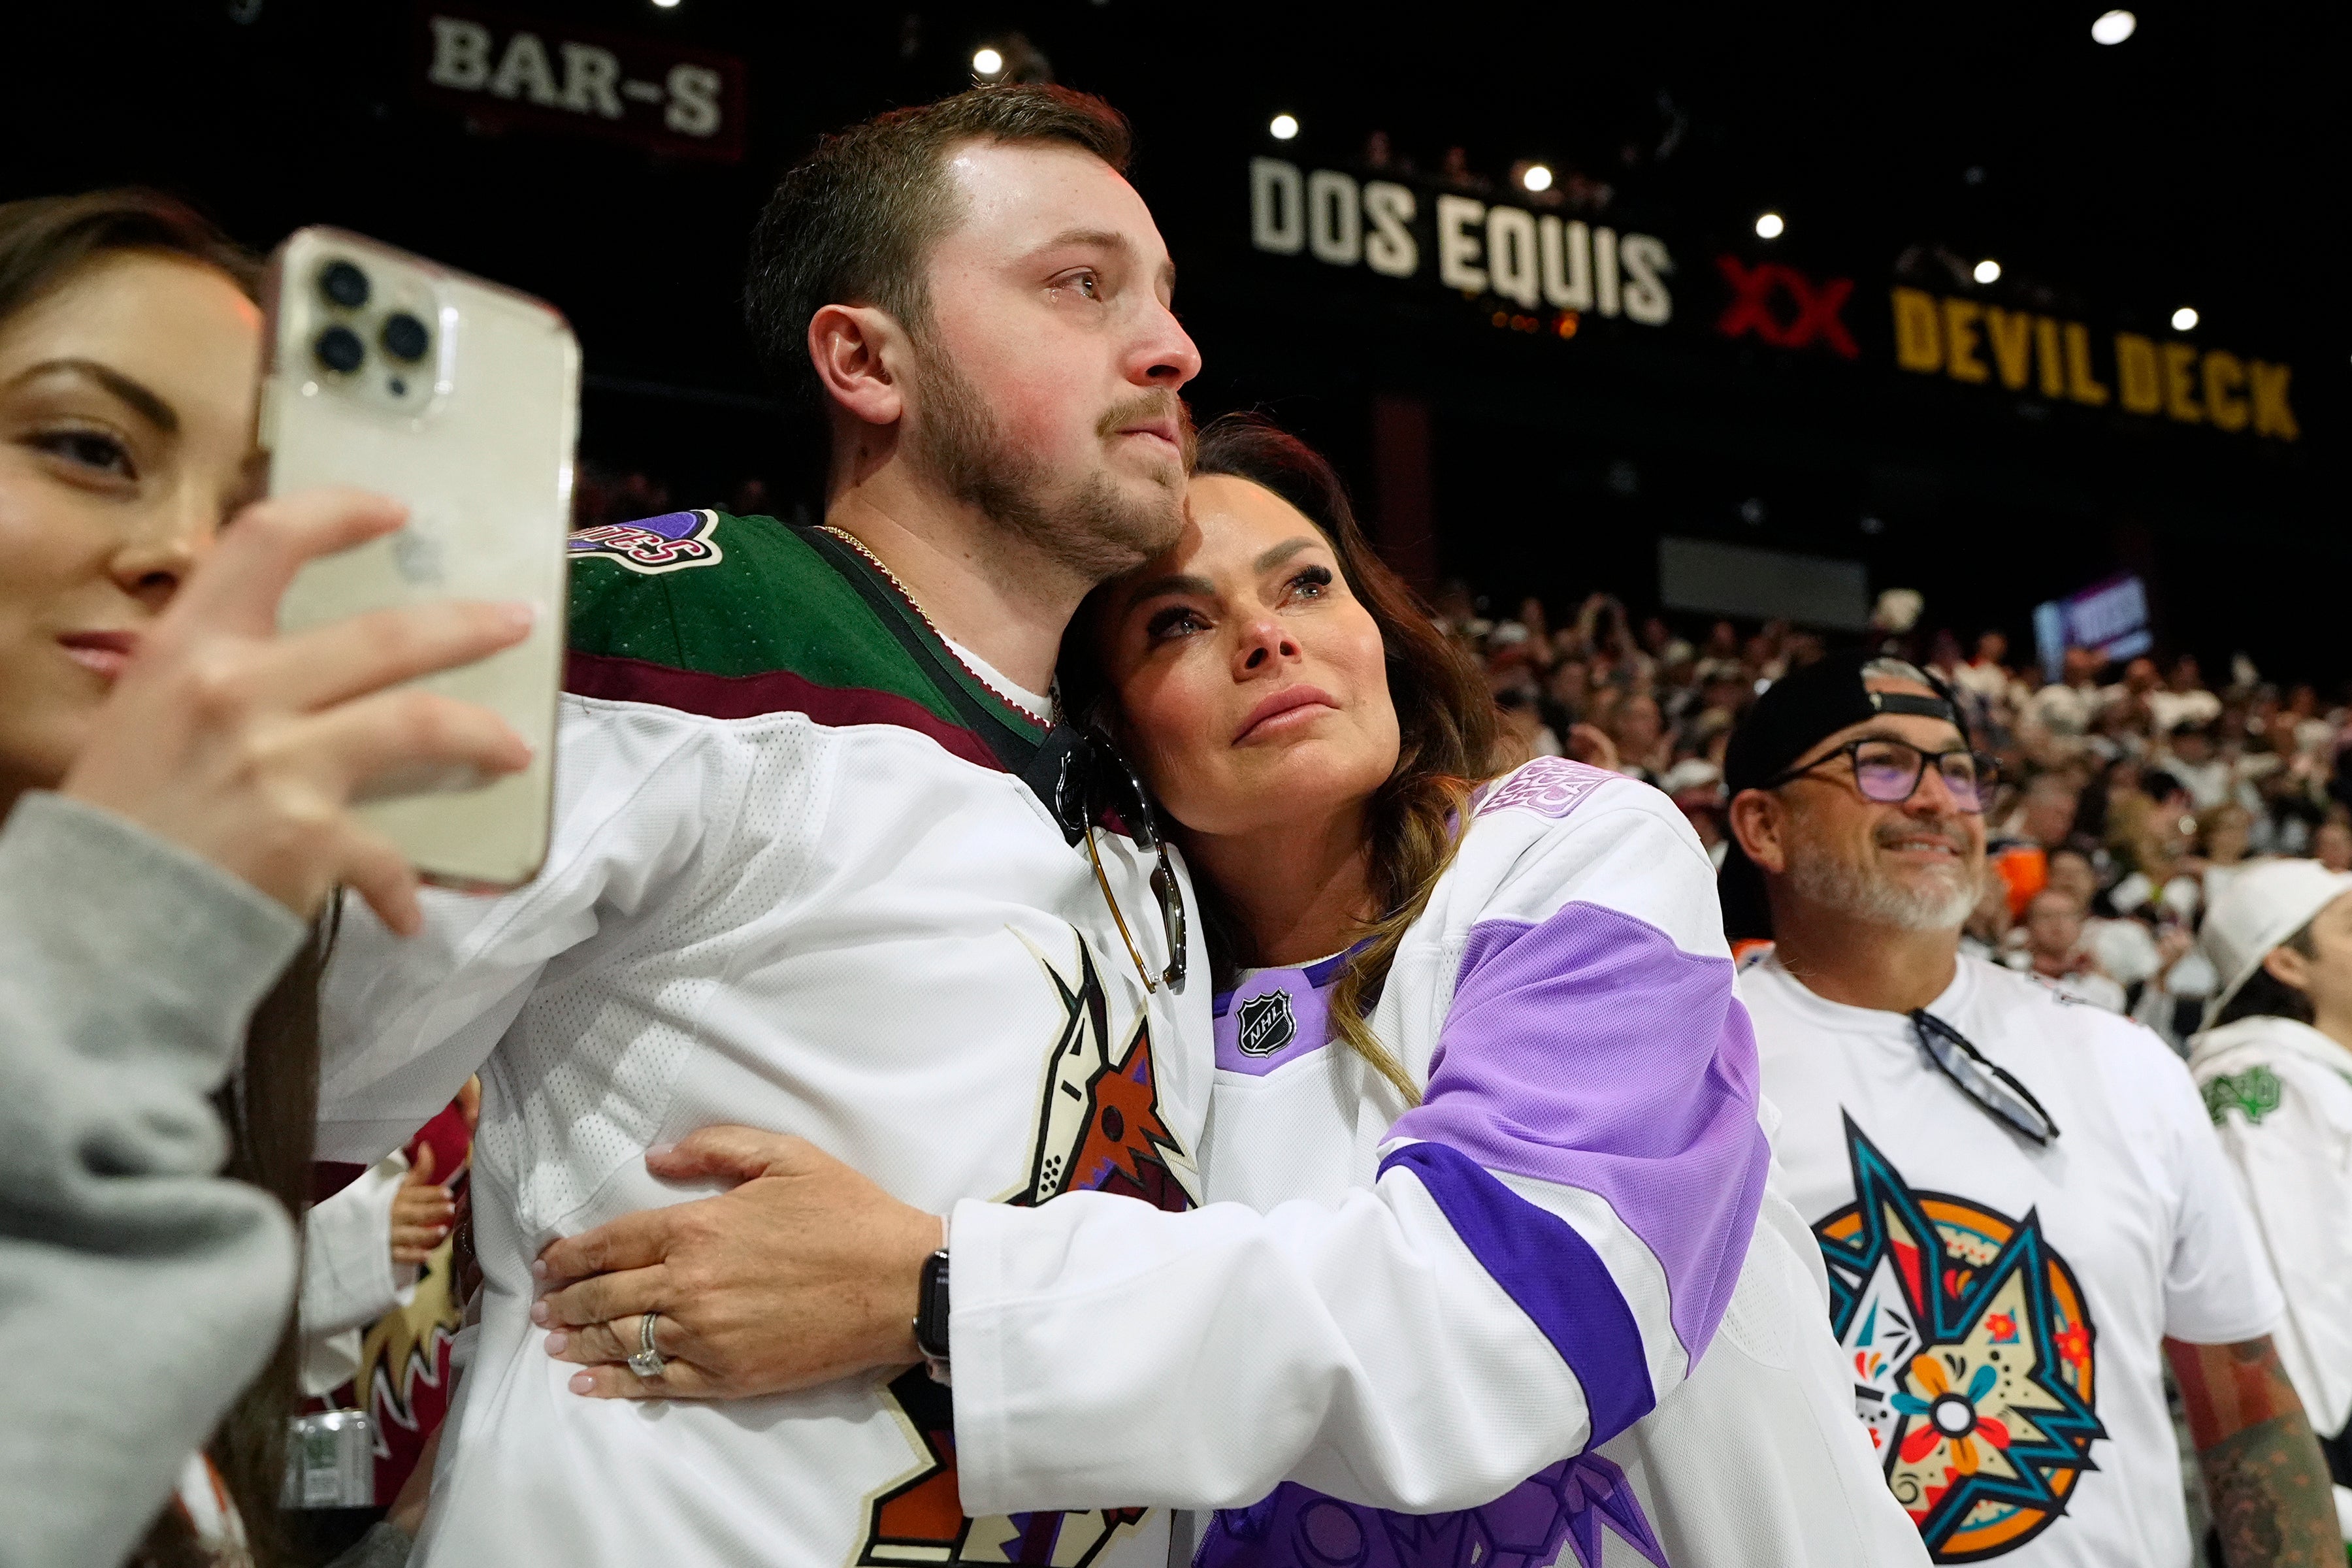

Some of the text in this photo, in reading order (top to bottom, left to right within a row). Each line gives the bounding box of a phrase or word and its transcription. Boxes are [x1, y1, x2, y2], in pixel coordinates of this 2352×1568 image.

[429, 16, 720, 136] BAR-S
[1249, 155, 1419, 278] DOS
[1437, 193, 1674, 326] EQUIS
[1891, 286, 2108, 406] DEVIL
[2114, 331, 2299, 442] DECK
[1250, 1006, 1282, 1045] NHL
